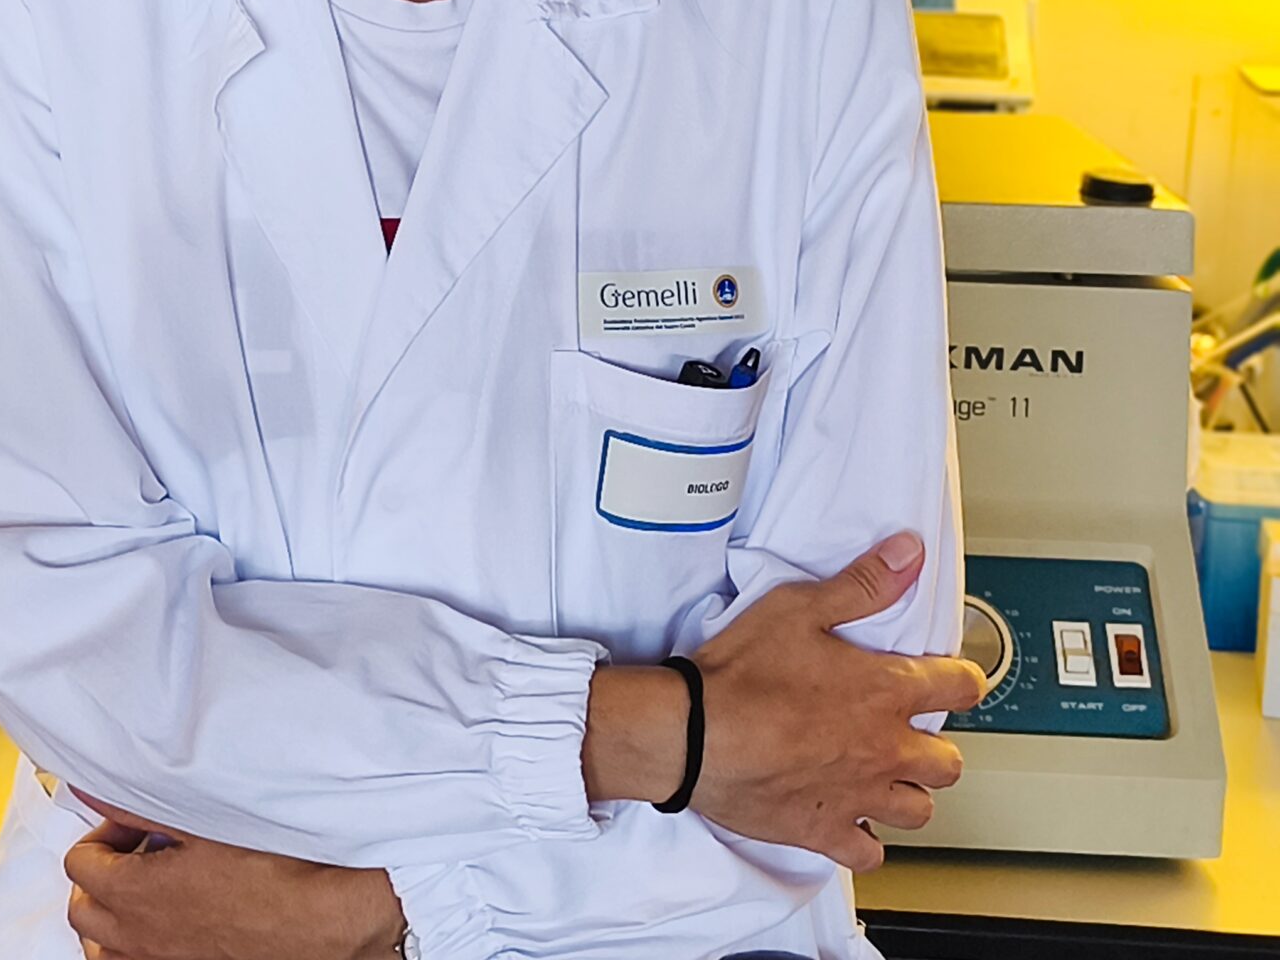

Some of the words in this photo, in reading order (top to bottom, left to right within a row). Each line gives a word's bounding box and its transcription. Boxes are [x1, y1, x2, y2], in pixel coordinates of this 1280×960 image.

[600, 280, 697, 308] Gemelli
[1010, 397, 1029, 418] 11
[1094, 585, 1141, 594] POWER
[1112, 607, 1132, 616] ON
[1061, 701, 1104, 711] START
[1121, 703, 1147, 713] OFF
